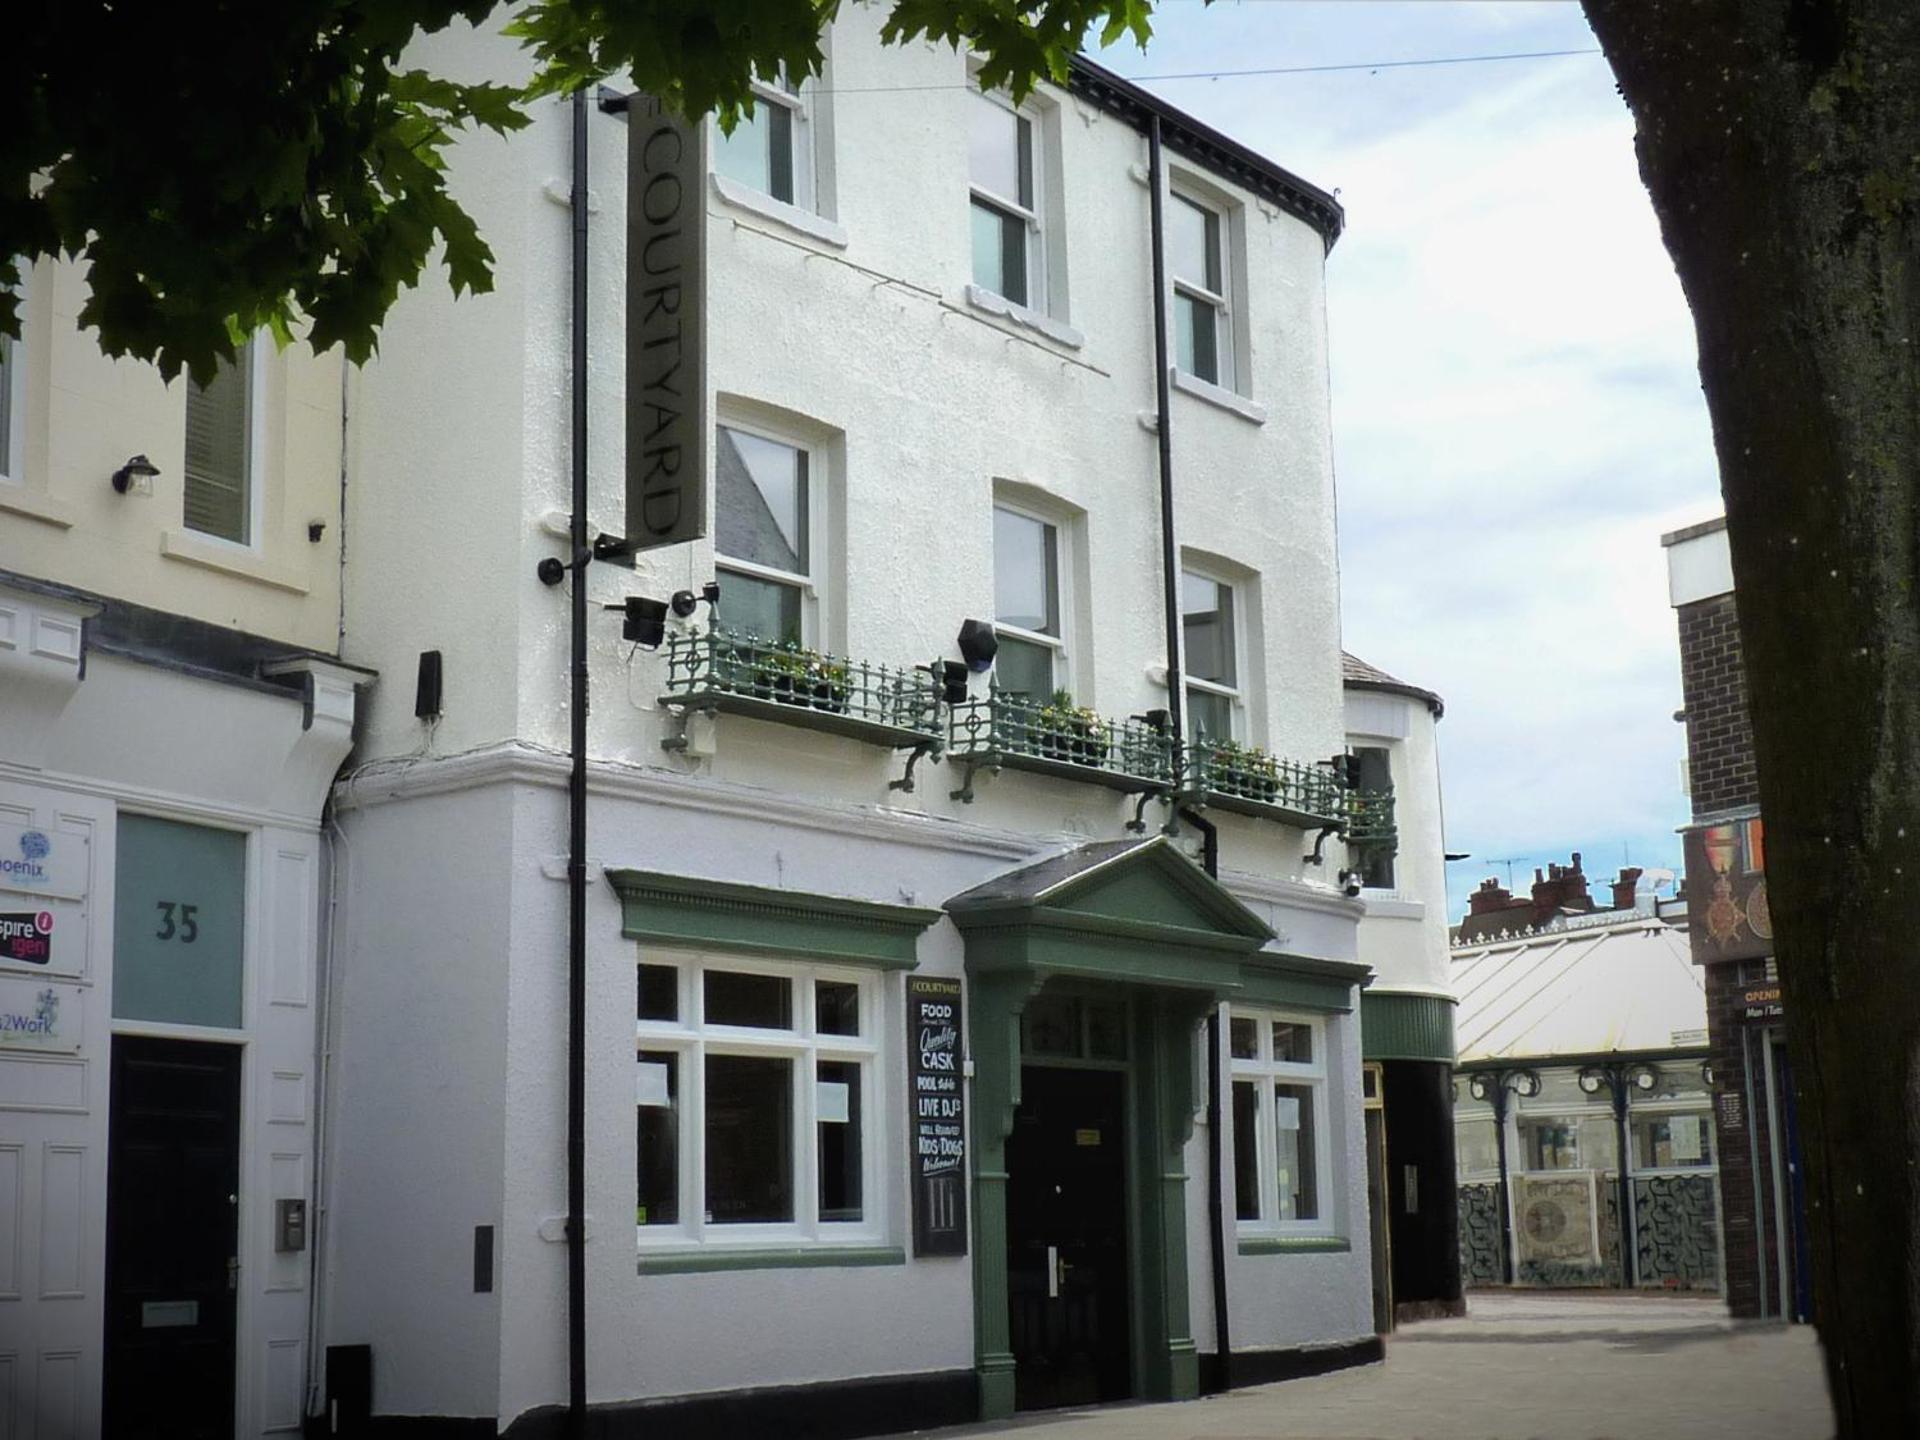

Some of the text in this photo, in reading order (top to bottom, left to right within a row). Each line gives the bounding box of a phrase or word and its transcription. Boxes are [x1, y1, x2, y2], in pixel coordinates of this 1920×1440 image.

[643, 126, 682, 537] COURTYARD
[155, 901, 198, 943] 35
[921, 1003, 952, 1018] FOOD
[922, 1053, 954, 1071] CASK
[917, 1076, 937, 1091] POOL
[919, 1098, 939, 1117] LIVE
